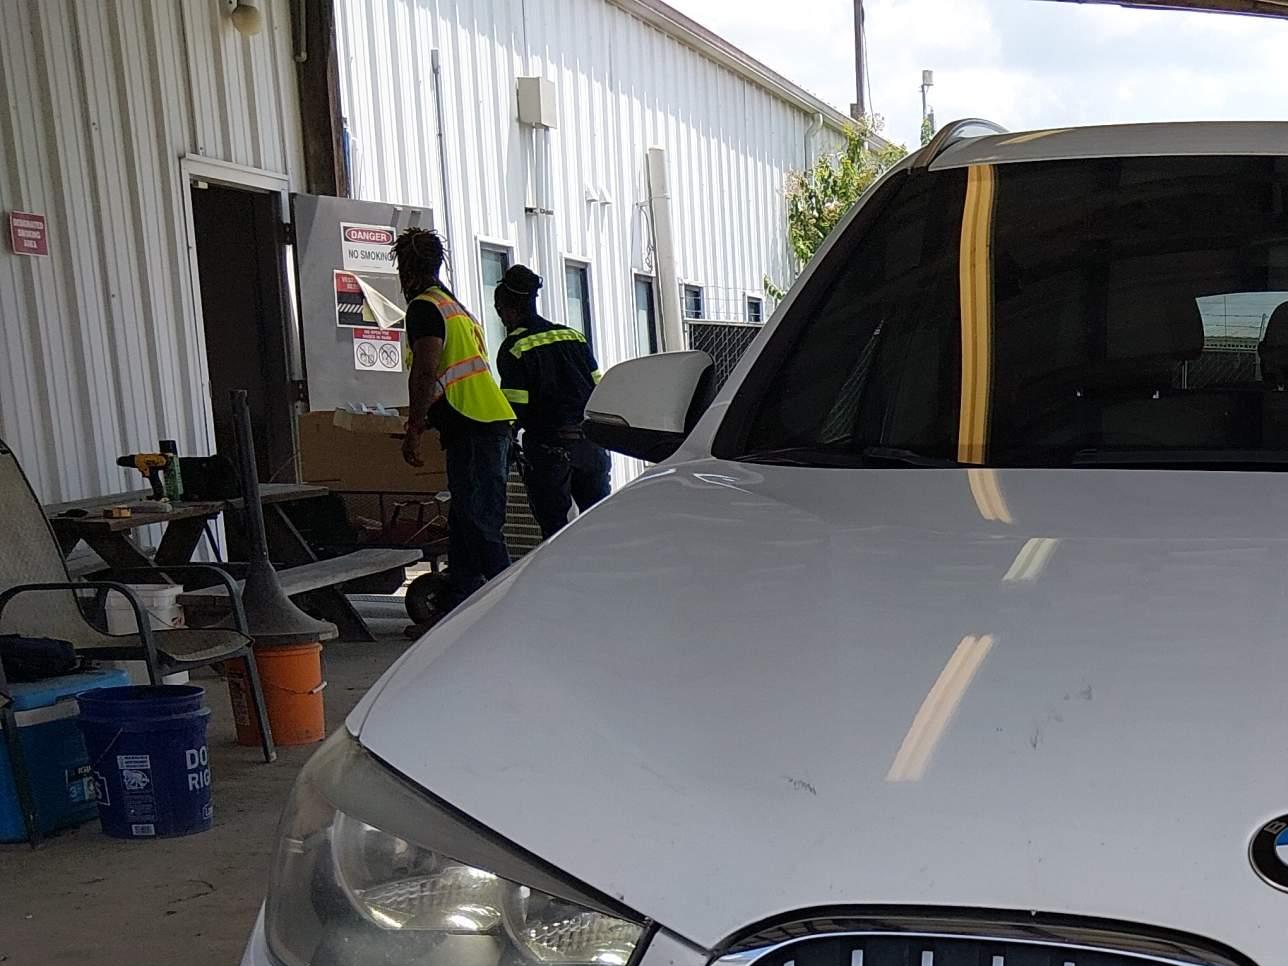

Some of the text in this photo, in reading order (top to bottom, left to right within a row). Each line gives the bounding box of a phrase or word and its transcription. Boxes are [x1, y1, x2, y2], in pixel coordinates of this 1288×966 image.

[351, 230, 388, 241] DANGER
[348, 249, 394, 261] NO SMOKING
[185, 745, 209, 770] DO
